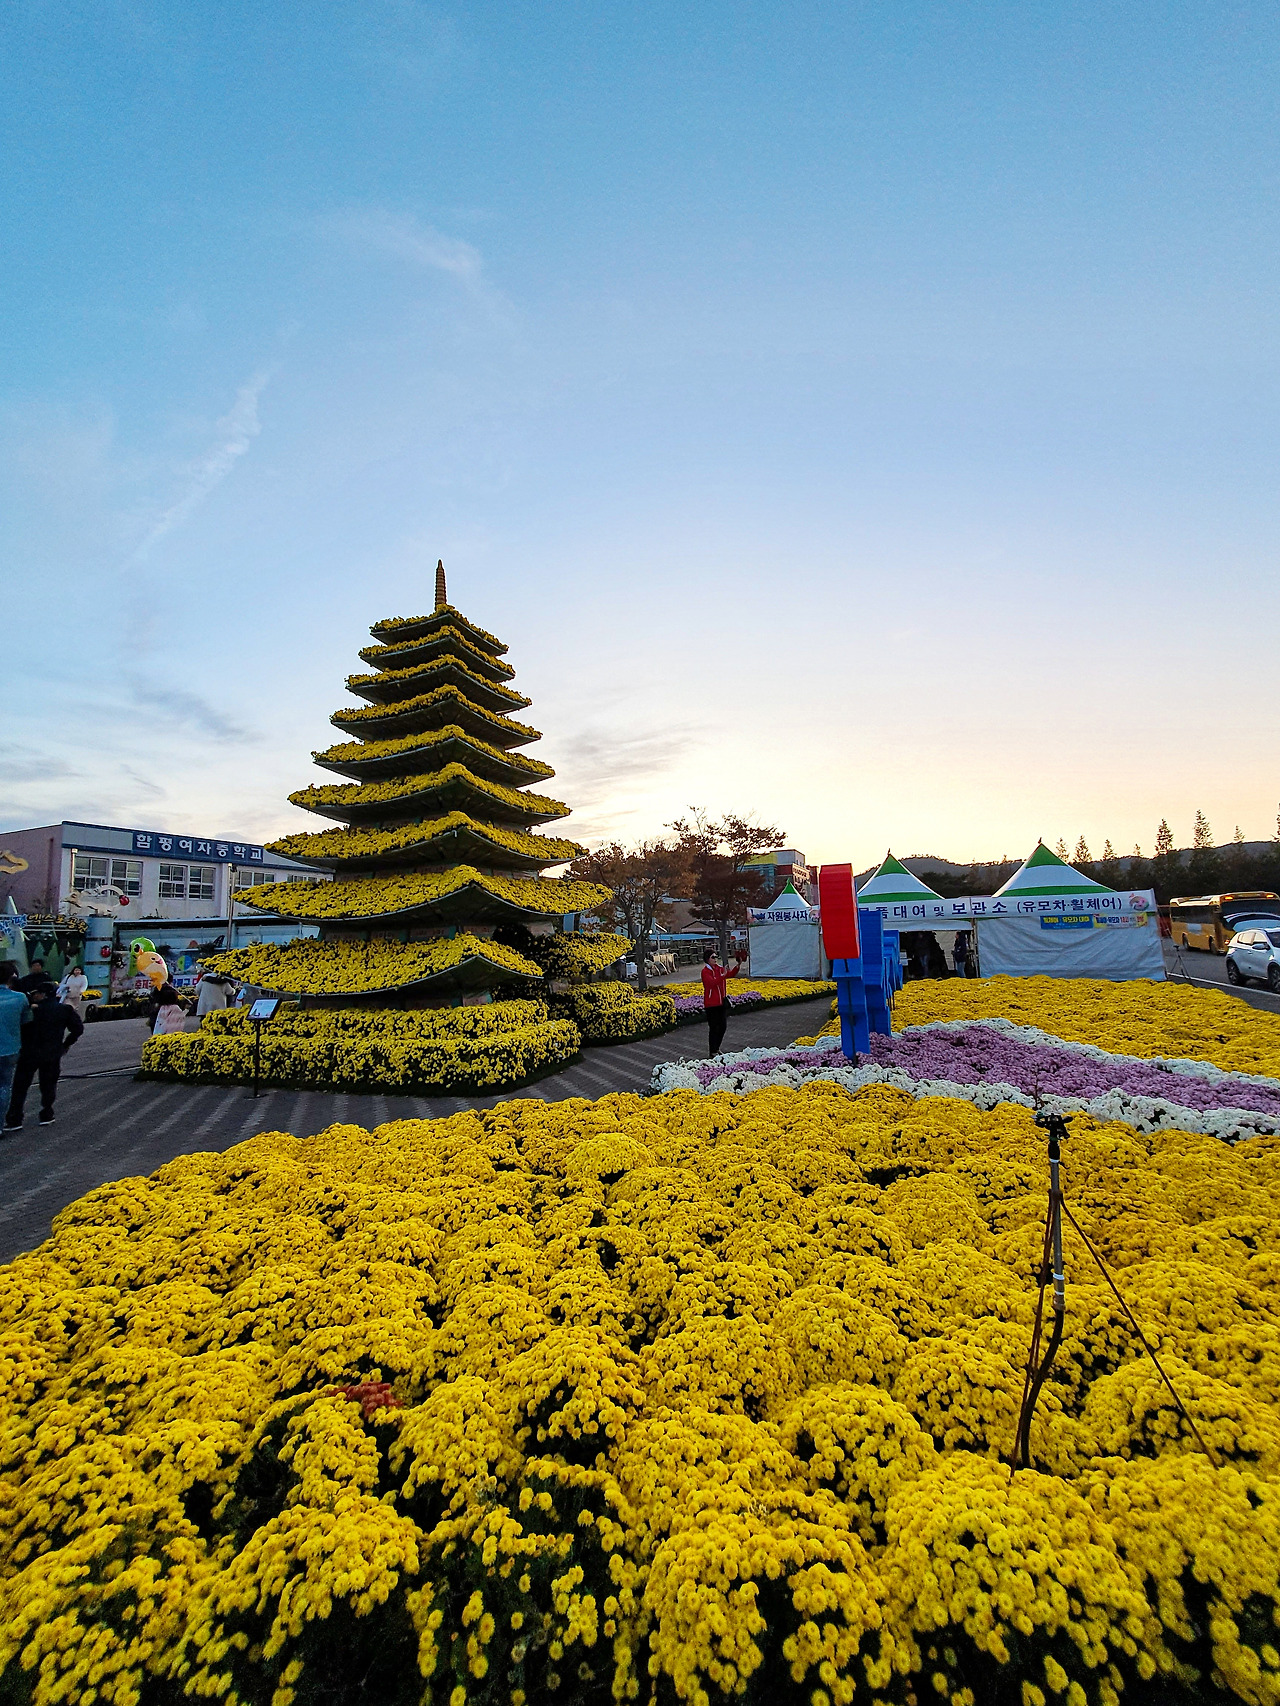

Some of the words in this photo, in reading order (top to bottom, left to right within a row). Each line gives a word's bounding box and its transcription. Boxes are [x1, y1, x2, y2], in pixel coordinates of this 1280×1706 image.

[136, 834, 262, 860] 함평여자중학교
[767, 909, 808, 922] 자원봉사자
[933, 906, 945, 917] 및
[951, 901, 1008, 916] 보관소
